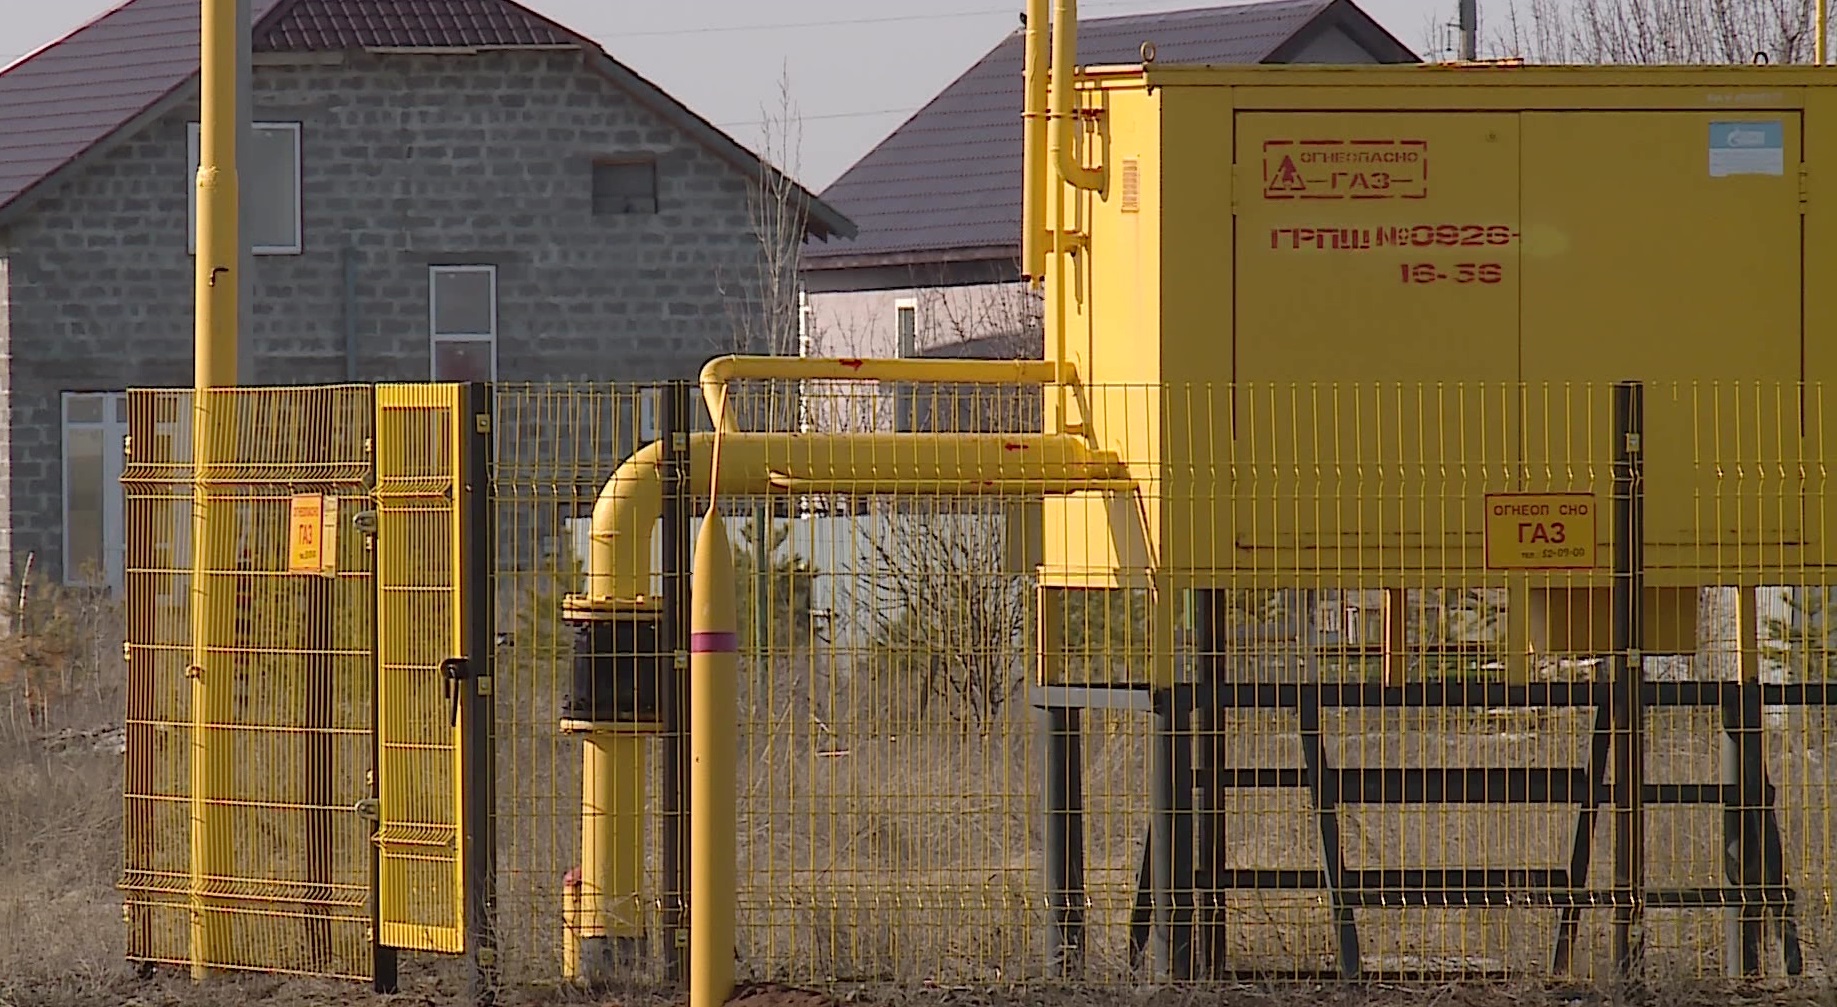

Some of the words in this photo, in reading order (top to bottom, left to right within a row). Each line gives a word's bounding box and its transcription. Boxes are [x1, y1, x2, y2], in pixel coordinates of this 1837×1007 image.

[1300, 151, 1418, 163] ОГНЕОПАСНО
[1331, 172, 1390, 190] ГАЗ
[1518, 522, 1566, 544] ГАЗ
